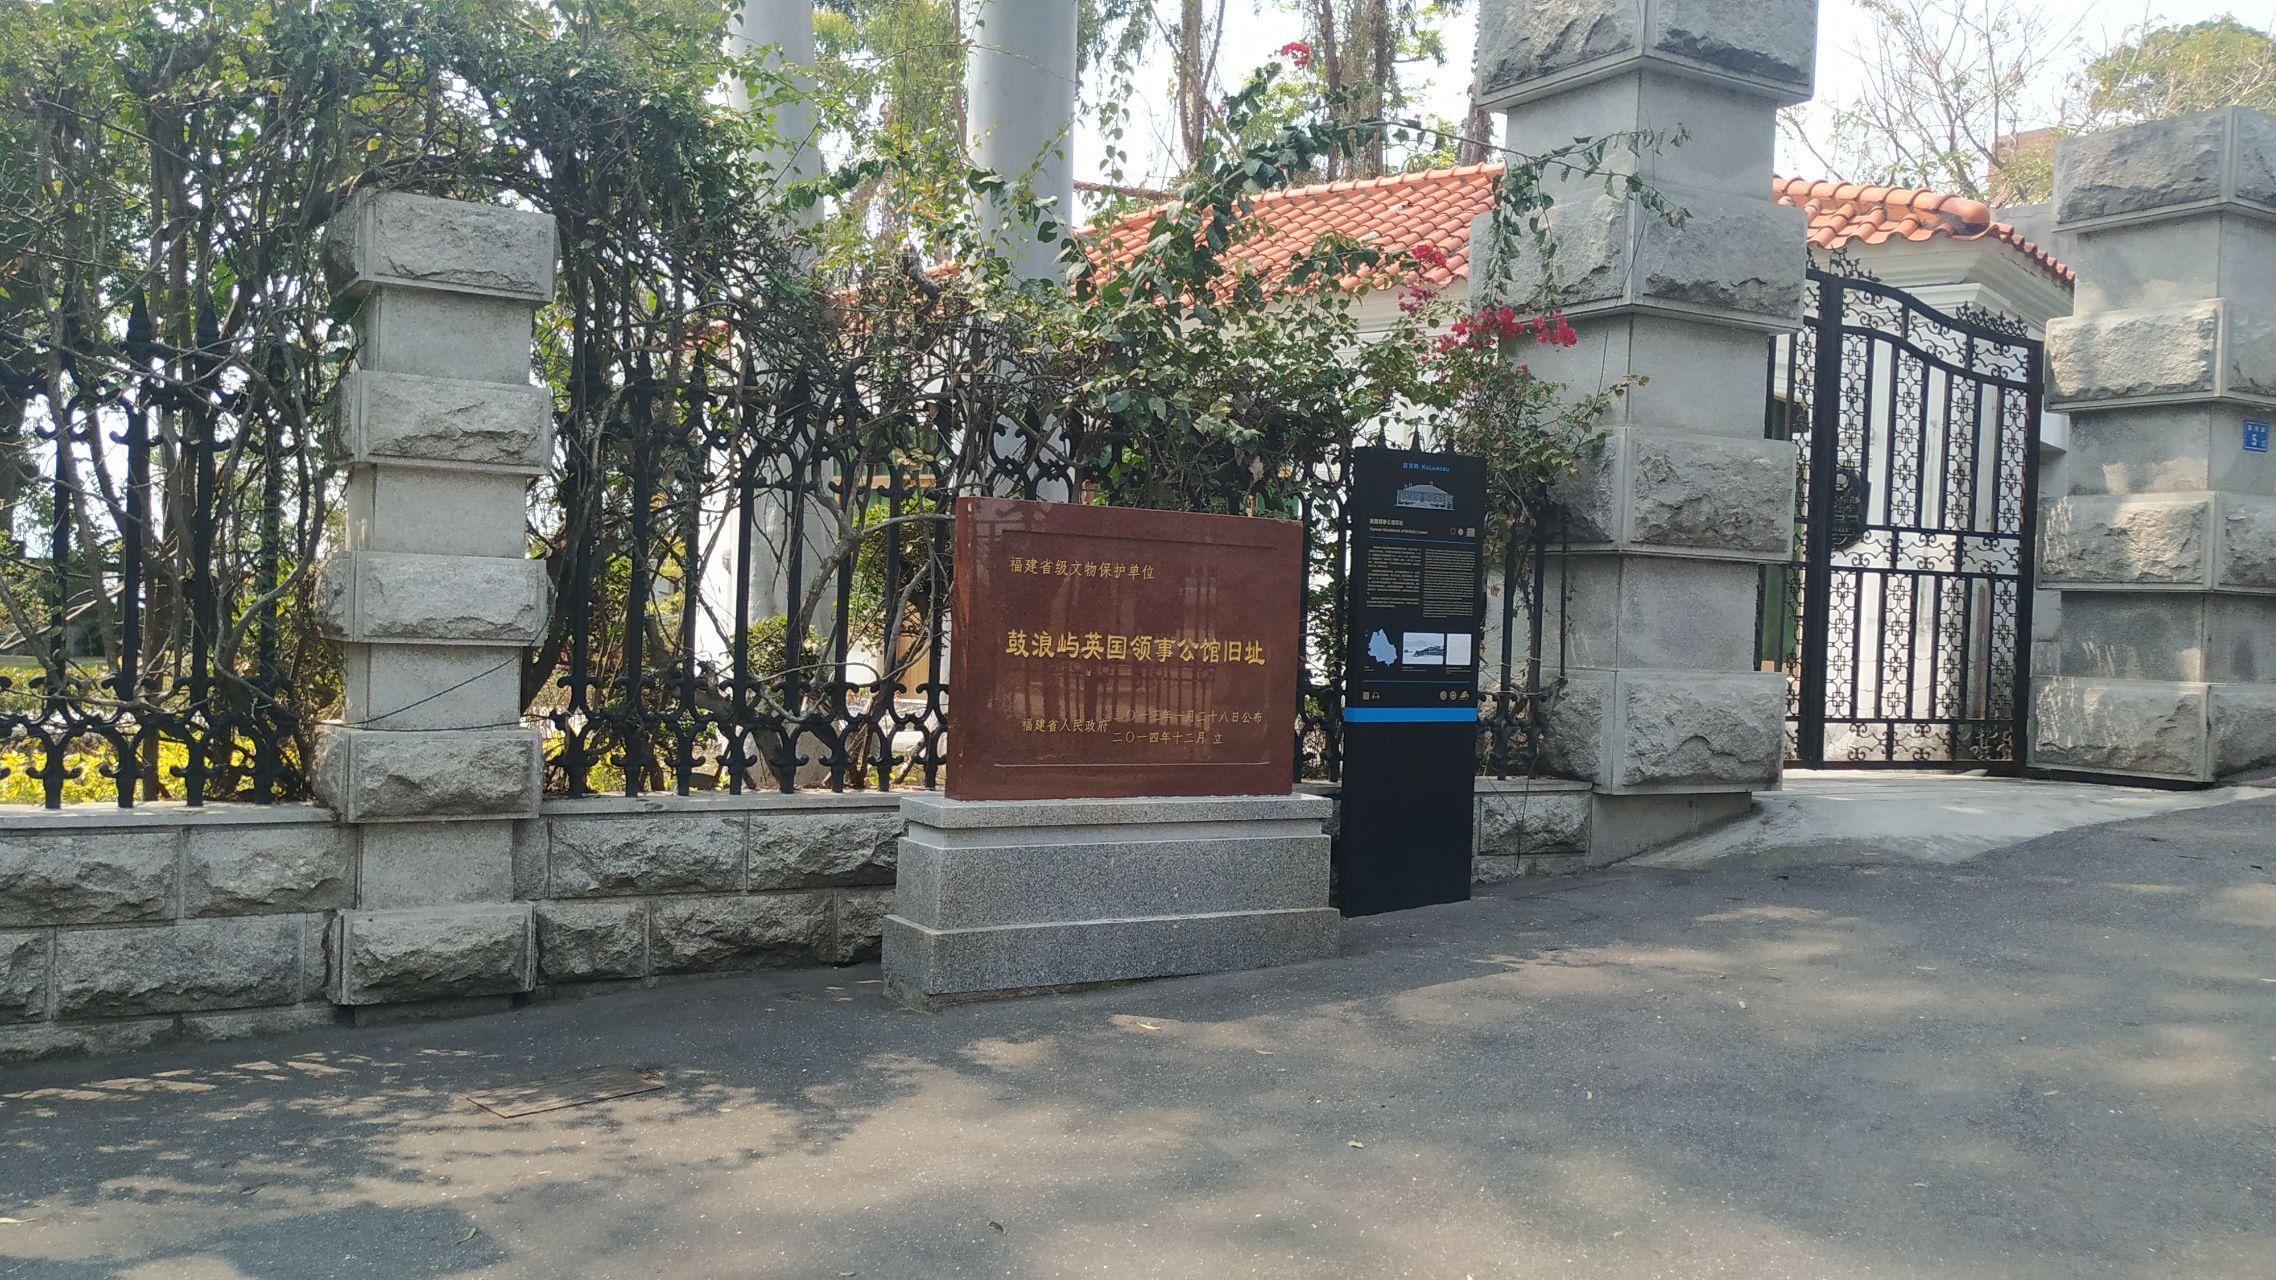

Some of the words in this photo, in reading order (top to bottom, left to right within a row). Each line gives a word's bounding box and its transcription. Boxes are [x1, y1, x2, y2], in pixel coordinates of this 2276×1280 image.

[1009, 557, 1155, 581] 福建省级文物保护单位
[1005, 628, 1266, 666] 鼓浪屿英国领事公馆旧址
[1021, 717, 1109, 733] 福建省人民政府
[1212, 732, 1224, 745] 立
